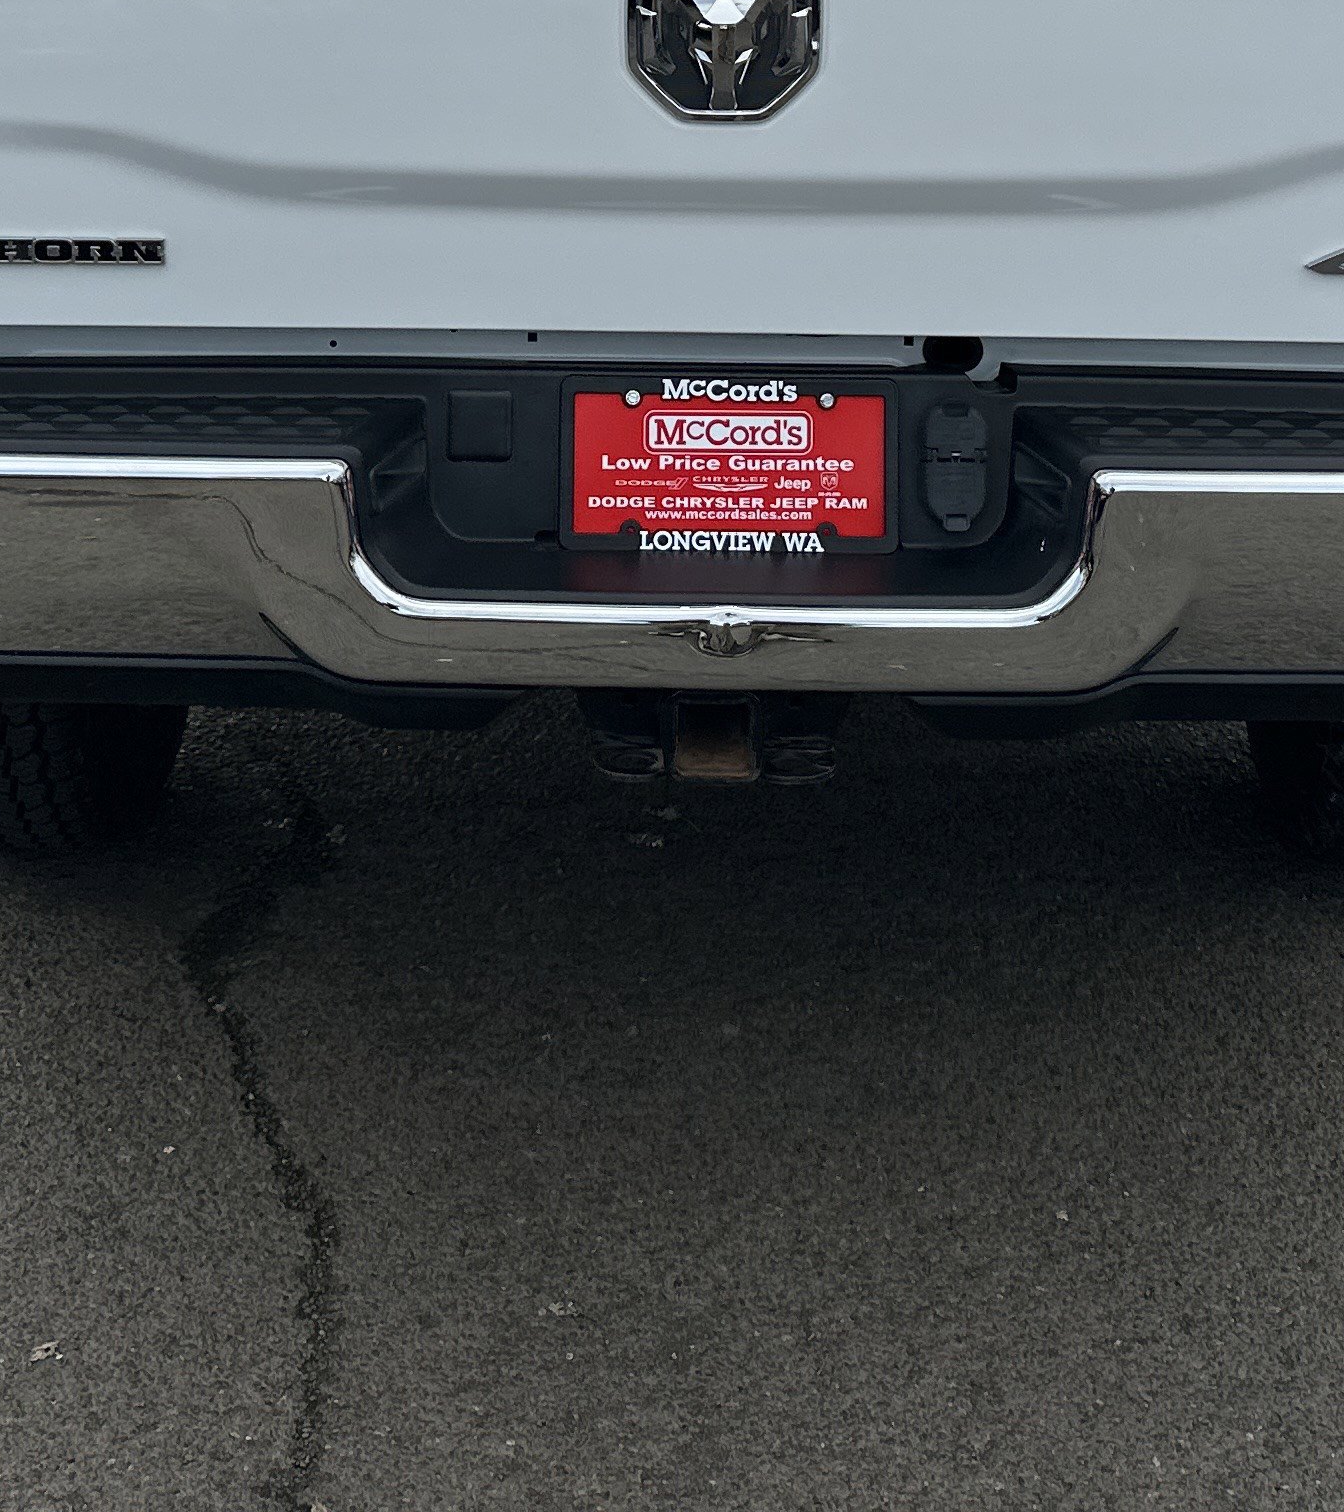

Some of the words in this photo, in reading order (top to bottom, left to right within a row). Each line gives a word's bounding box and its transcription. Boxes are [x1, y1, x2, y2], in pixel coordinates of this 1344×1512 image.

[662, 378, 798, 402] McCord's
[654, 418, 803, 446] McCord's
[601, 454, 652, 471] Low
[659, 454, 721, 471] Price
[728, 455, 855, 472] Guarantee
[692, 475, 769, 483] CHRYSLER
[773, 475, 812, 492] Jeep
[587, 496, 657, 508] DODGE
[661, 496, 765, 509] CHRYSLER
[769, 497, 819, 509] JEEP
[824, 497, 868, 510] RAM
[644, 509, 813, 521] www.mccordsales.com
[639, 530, 776, 551] LONGVIEW
[781, 532, 825, 552] WA
